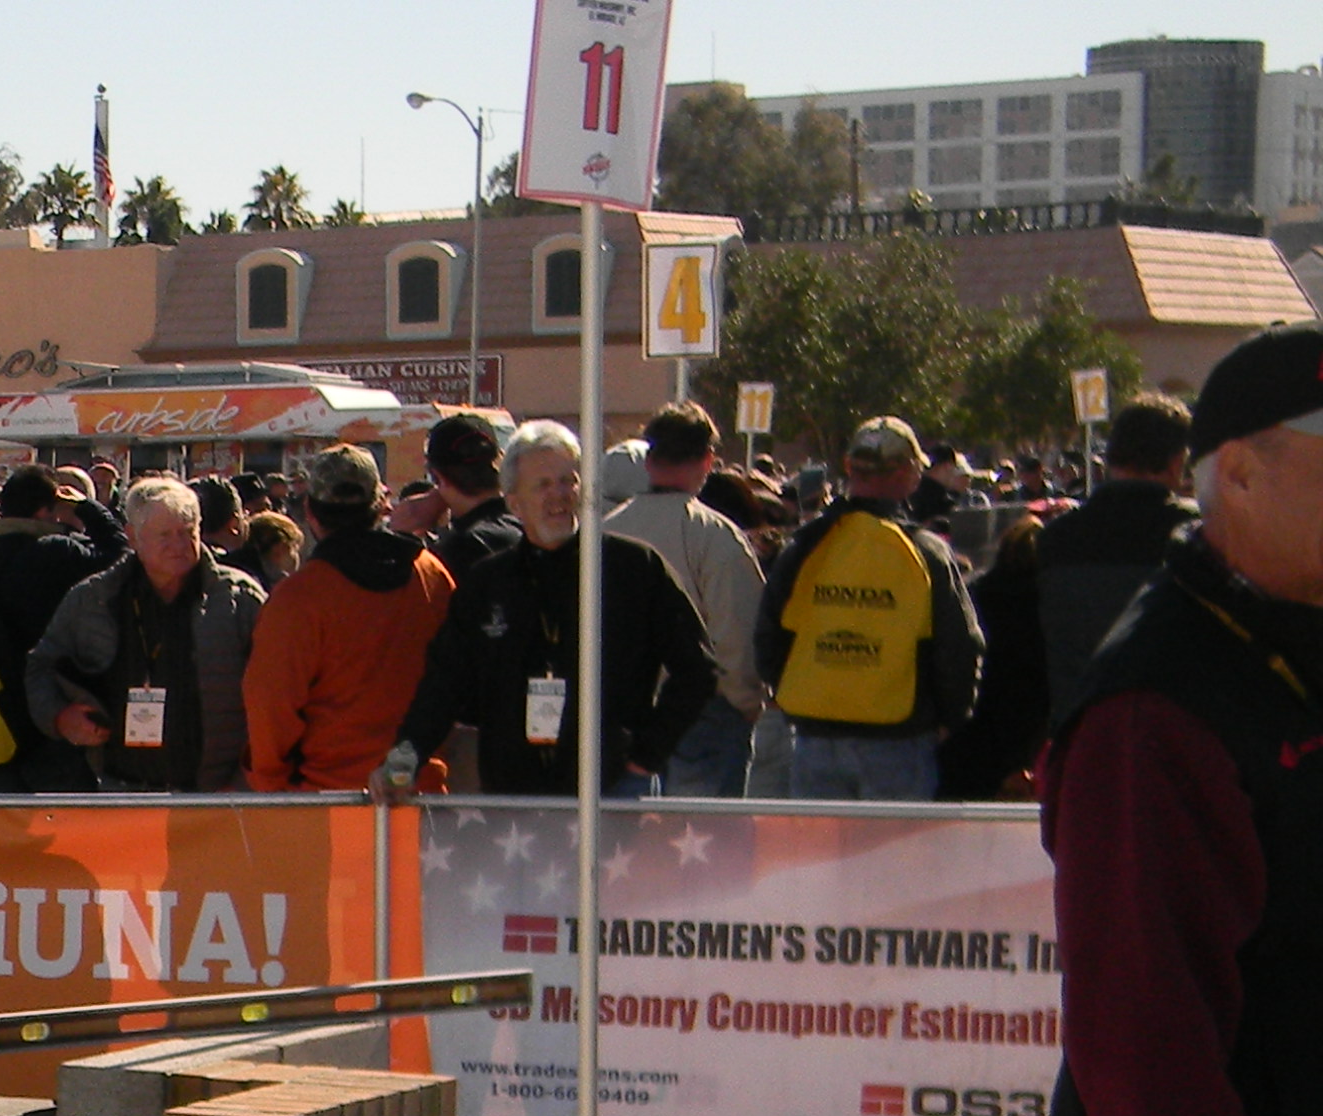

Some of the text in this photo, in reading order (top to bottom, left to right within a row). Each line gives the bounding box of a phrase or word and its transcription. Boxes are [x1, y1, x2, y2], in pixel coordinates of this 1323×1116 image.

[578, 41, 624, 135] 11
[658, 256, 706, 343] 4
[95, 393, 240, 434] curbside
[744, 390, 771, 429] 11
[814, 925, 1017, 974] SOFTWARE,
[1026, 933, 1062, 973] In
[541, 985, 1059, 1048] Msonry Computer Estimati
[460, 1059, 679, 1085] www.tradesens.com
